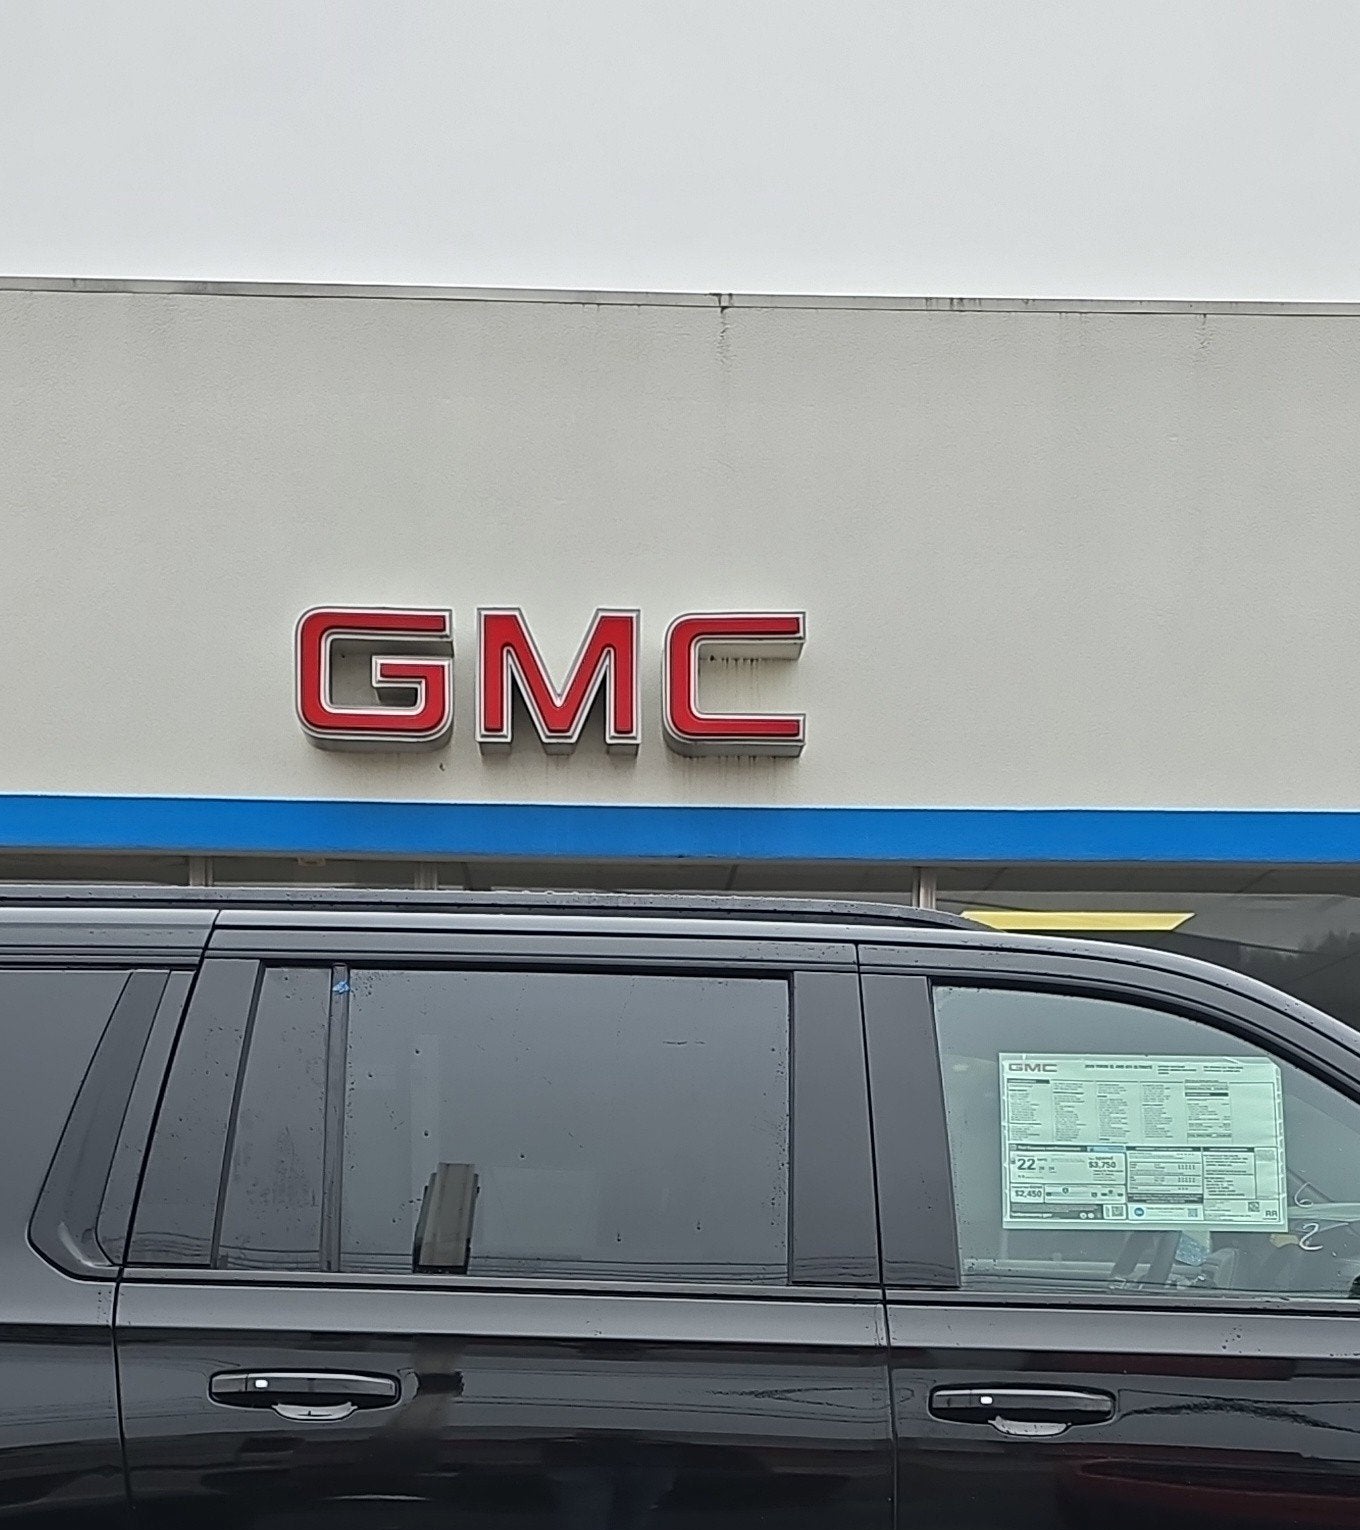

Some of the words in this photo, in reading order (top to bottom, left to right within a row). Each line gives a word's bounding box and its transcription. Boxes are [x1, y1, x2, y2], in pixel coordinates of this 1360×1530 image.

[295, 607, 807, 755] GMC
[1008, 1063, 1058, 1073] GMC
[1017, 1158, 1036, 1171] 22
